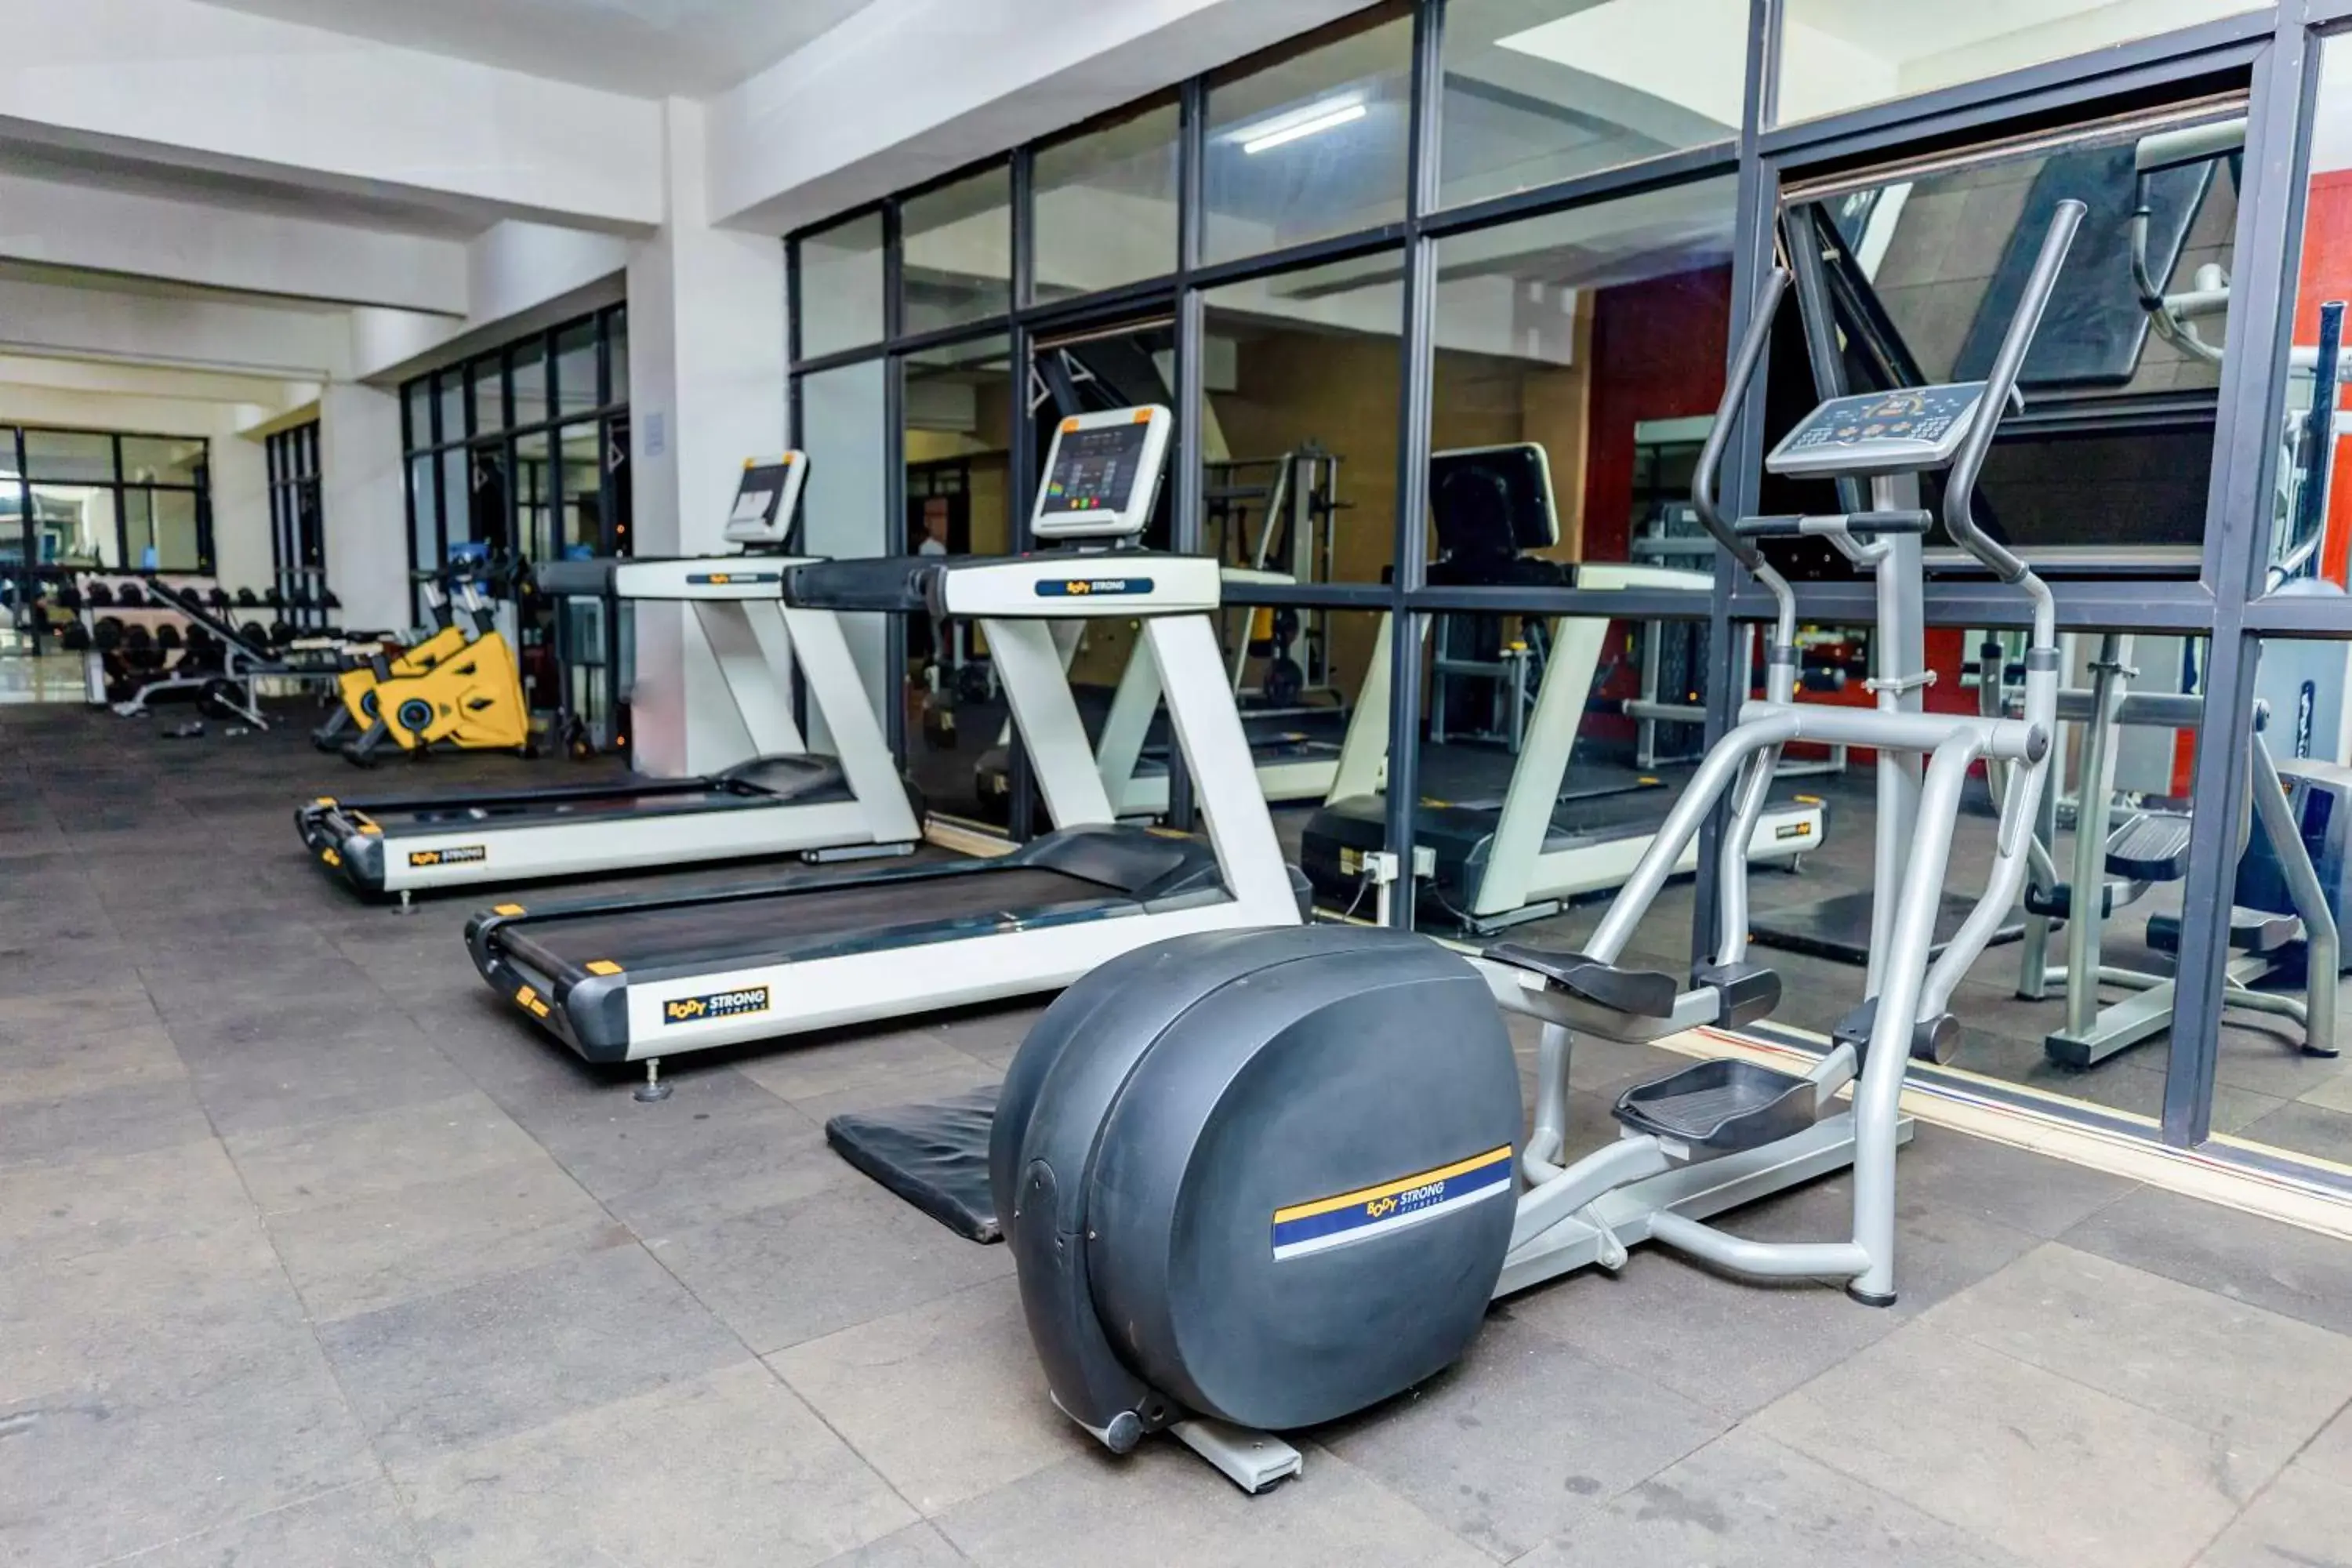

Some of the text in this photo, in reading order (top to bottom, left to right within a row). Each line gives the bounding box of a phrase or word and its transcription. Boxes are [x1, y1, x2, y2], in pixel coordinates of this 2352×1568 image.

[709, 989, 766, 1010] STRONG
[1367, 1181, 1445, 1218] BODY STRONG
